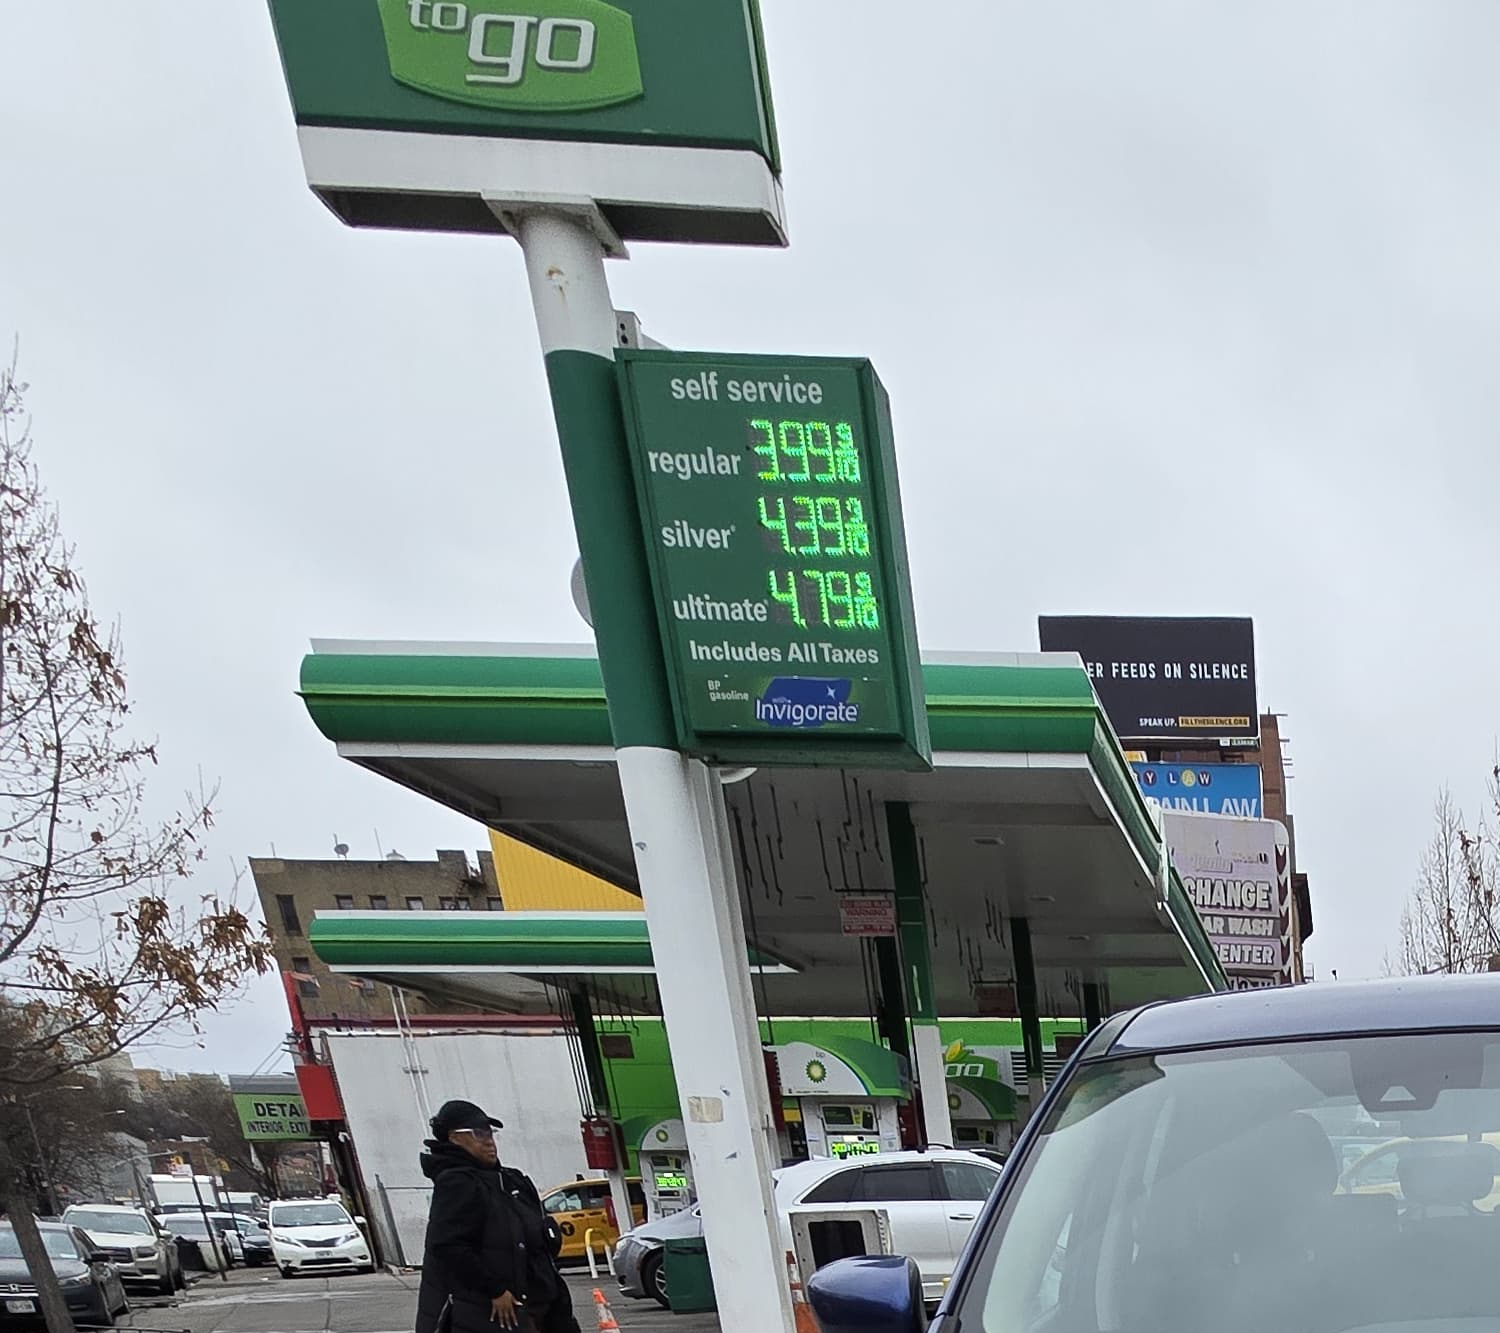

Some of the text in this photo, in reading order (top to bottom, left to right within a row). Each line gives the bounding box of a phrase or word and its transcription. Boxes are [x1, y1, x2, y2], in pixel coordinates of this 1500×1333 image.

[408, 0, 468, 31] to
[466, 13, 596, 84] go
[670, 371, 823, 404] self service
[648, 446, 741, 480] regular
[661, 520, 733, 549] silver
[673, 594, 769, 622] ultimate
[689, 639, 879, 664] Includes All Taxes
[1111, 662, 1156, 679] FEEDS
[1164, 663, 1182, 679] ON
[1190, 663, 1248, 679] SILENCE
[707, 679, 721, 691] BP
[708, 690, 749, 702] gasoline
[756, 699, 858, 726] Invigorate
[1139, 717, 1164, 727] SPEAK
[1203, 797, 1258, 818] LAW
[1228, 917, 1274, 937] WASH
